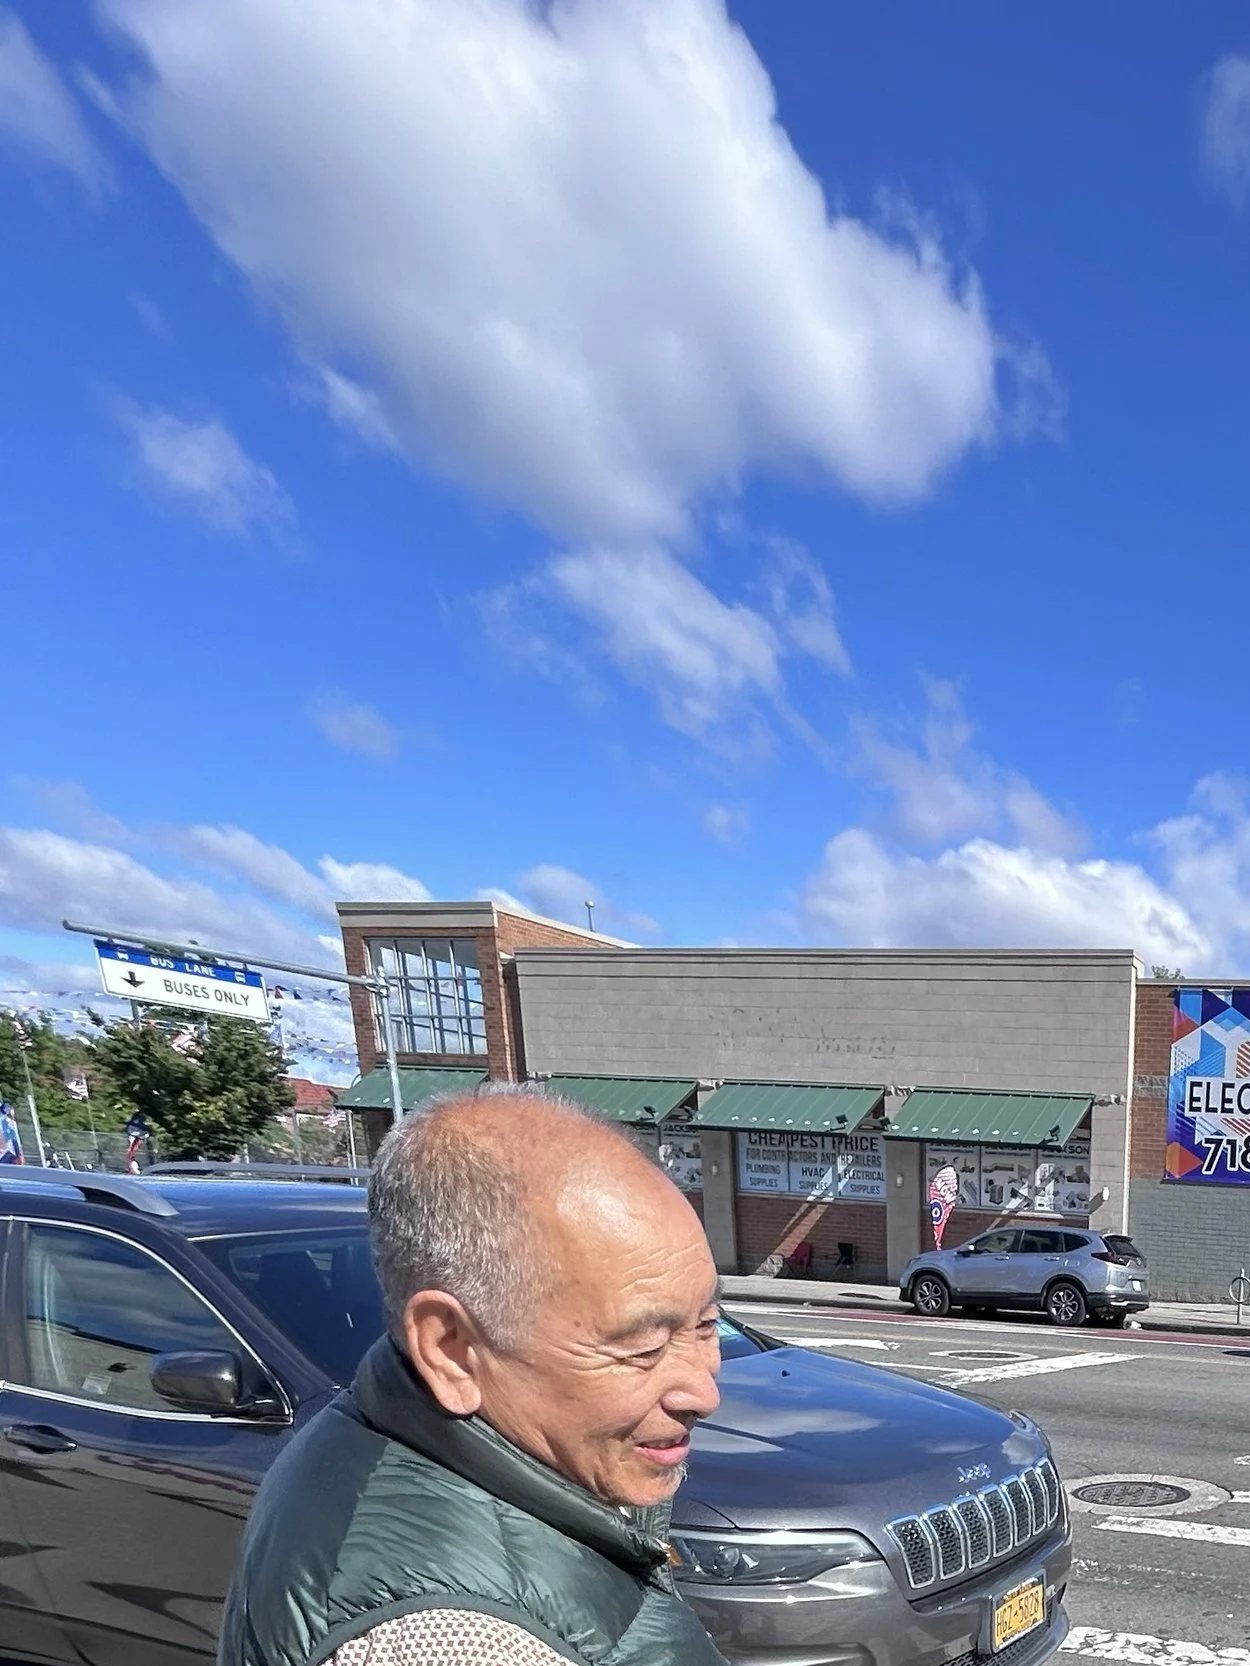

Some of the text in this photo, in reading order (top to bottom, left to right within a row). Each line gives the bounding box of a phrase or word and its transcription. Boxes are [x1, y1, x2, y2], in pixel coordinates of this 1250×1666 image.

[150, 956, 216, 978] BUS LANE
[164, 979, 250, 1007] BUSES ONLY
[748, 1131, 879, 1151] CHEAPEST PRICE
[746, 1147, 761, 1162] FOR
[762, 1148, 818, 1164] CONTRACTORS
[820, 1151, 838, 1165] AND
[745, 1163, 781, 1175] PLUMBING
[801, 1166, 826, 1178] HVAC
[843, 1168, 886, 1182] ELECTRICAL
[749, 1177, 779, 1188] SUPPLIES
[799, 1180, 829, 1191] SUPPLIES
[850, 1184, 881, 1195] SUPPLIES
[956, 1463, 991, 1483] Jeep
